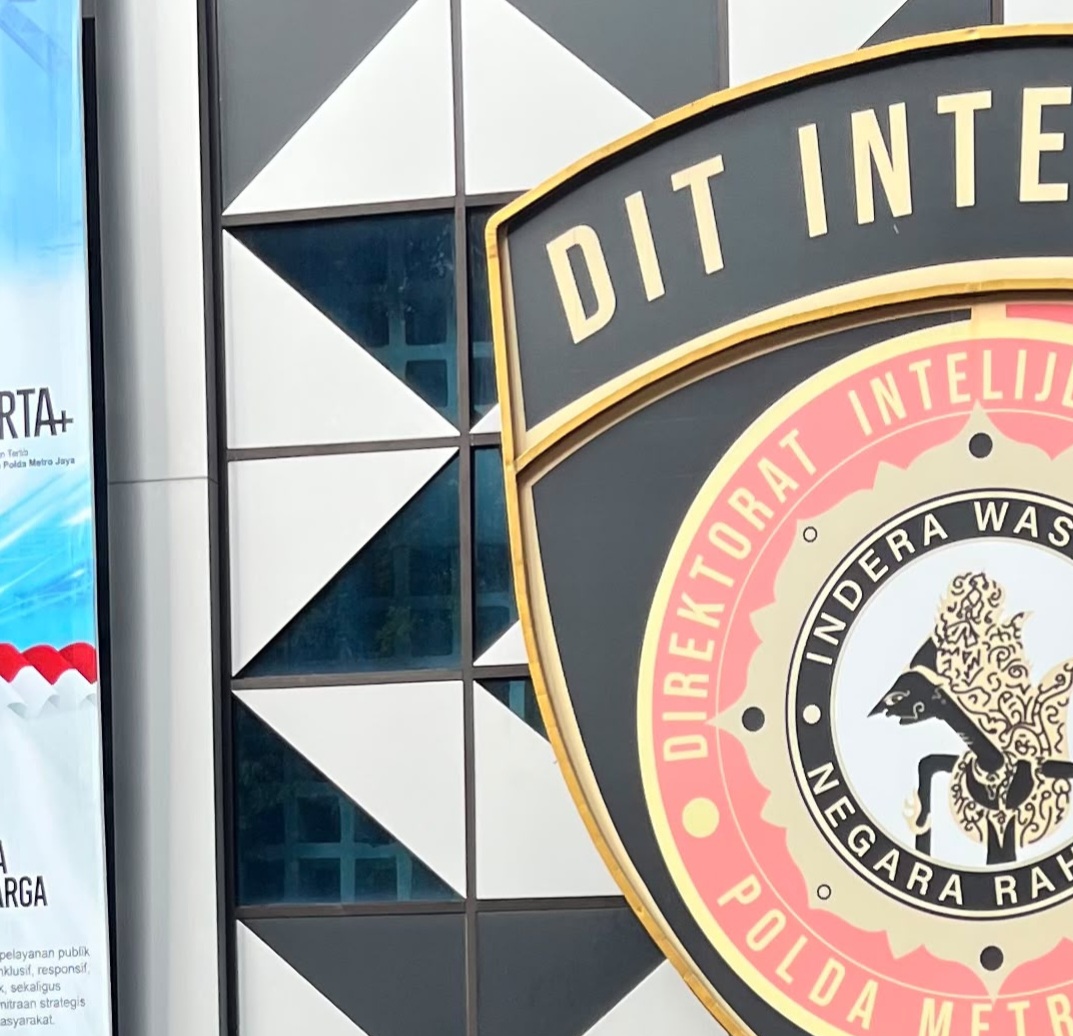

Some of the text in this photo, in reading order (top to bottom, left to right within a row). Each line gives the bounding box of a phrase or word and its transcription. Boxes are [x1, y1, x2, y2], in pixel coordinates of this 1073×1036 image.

[546, 153, 726, 345] DIT
[29, 459, 53, 467] Metro
[55, 457, 75, 466] Jaya
[664, 428, 818, 761] DIREKTORAT
[806, 511, 948, 666] INDERA
[807, 762, 964, 906] NEGARA
[10, 981, 61, 995] sekaligus
[38, 962, 90, 977] responsif,
[58, 946, 90, 960] publik
[717, 875, 879, 1030] POLDA
[40, 996, 86, 1010] strategis
